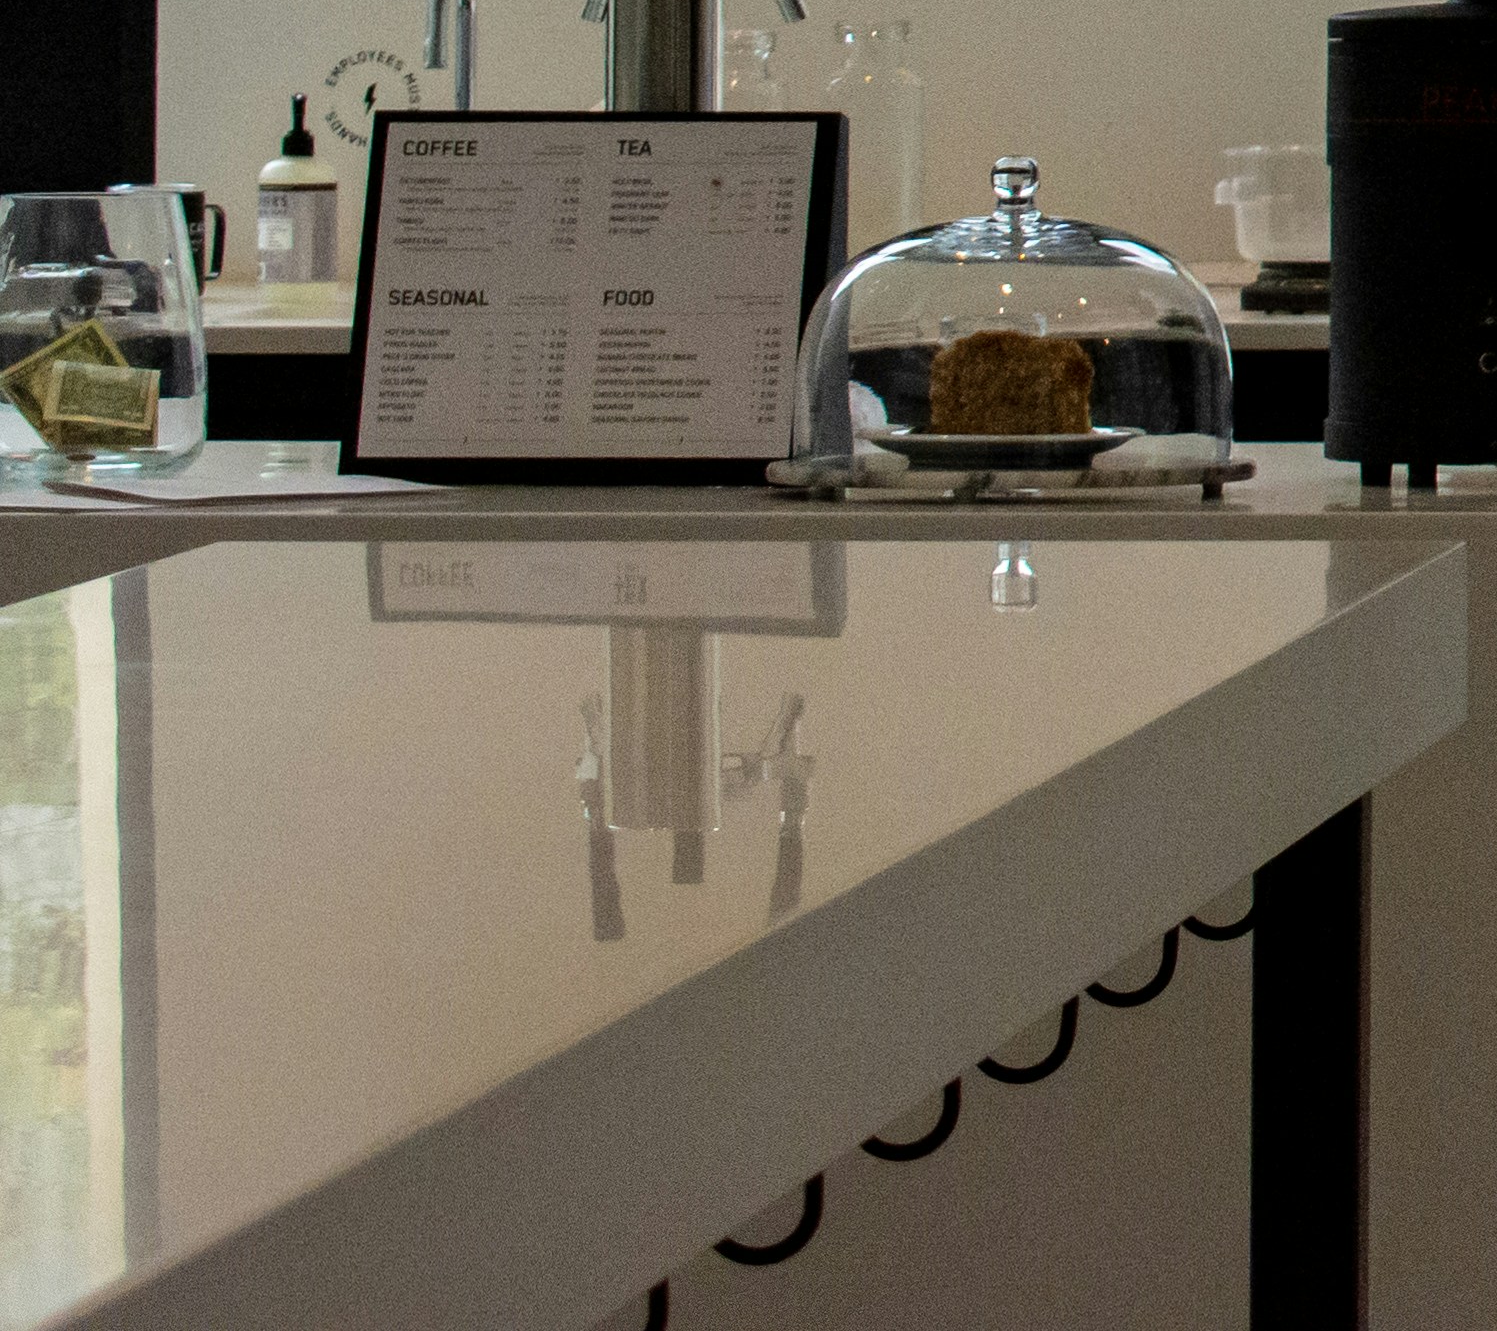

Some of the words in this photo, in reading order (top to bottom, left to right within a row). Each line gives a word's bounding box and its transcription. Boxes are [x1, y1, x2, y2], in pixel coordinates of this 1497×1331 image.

[325, 50, 405, 88] EMPLOYEES
[403, 72, 423, 111] MUS
[324, 109, 368, 147] HANDS
[402, 139, 479, 157] COFFEE
[616, 139, 653, 157] TEA
[388, 289, 490, 307] SEASONAL
[602, 289, 655, 307] FOOD
